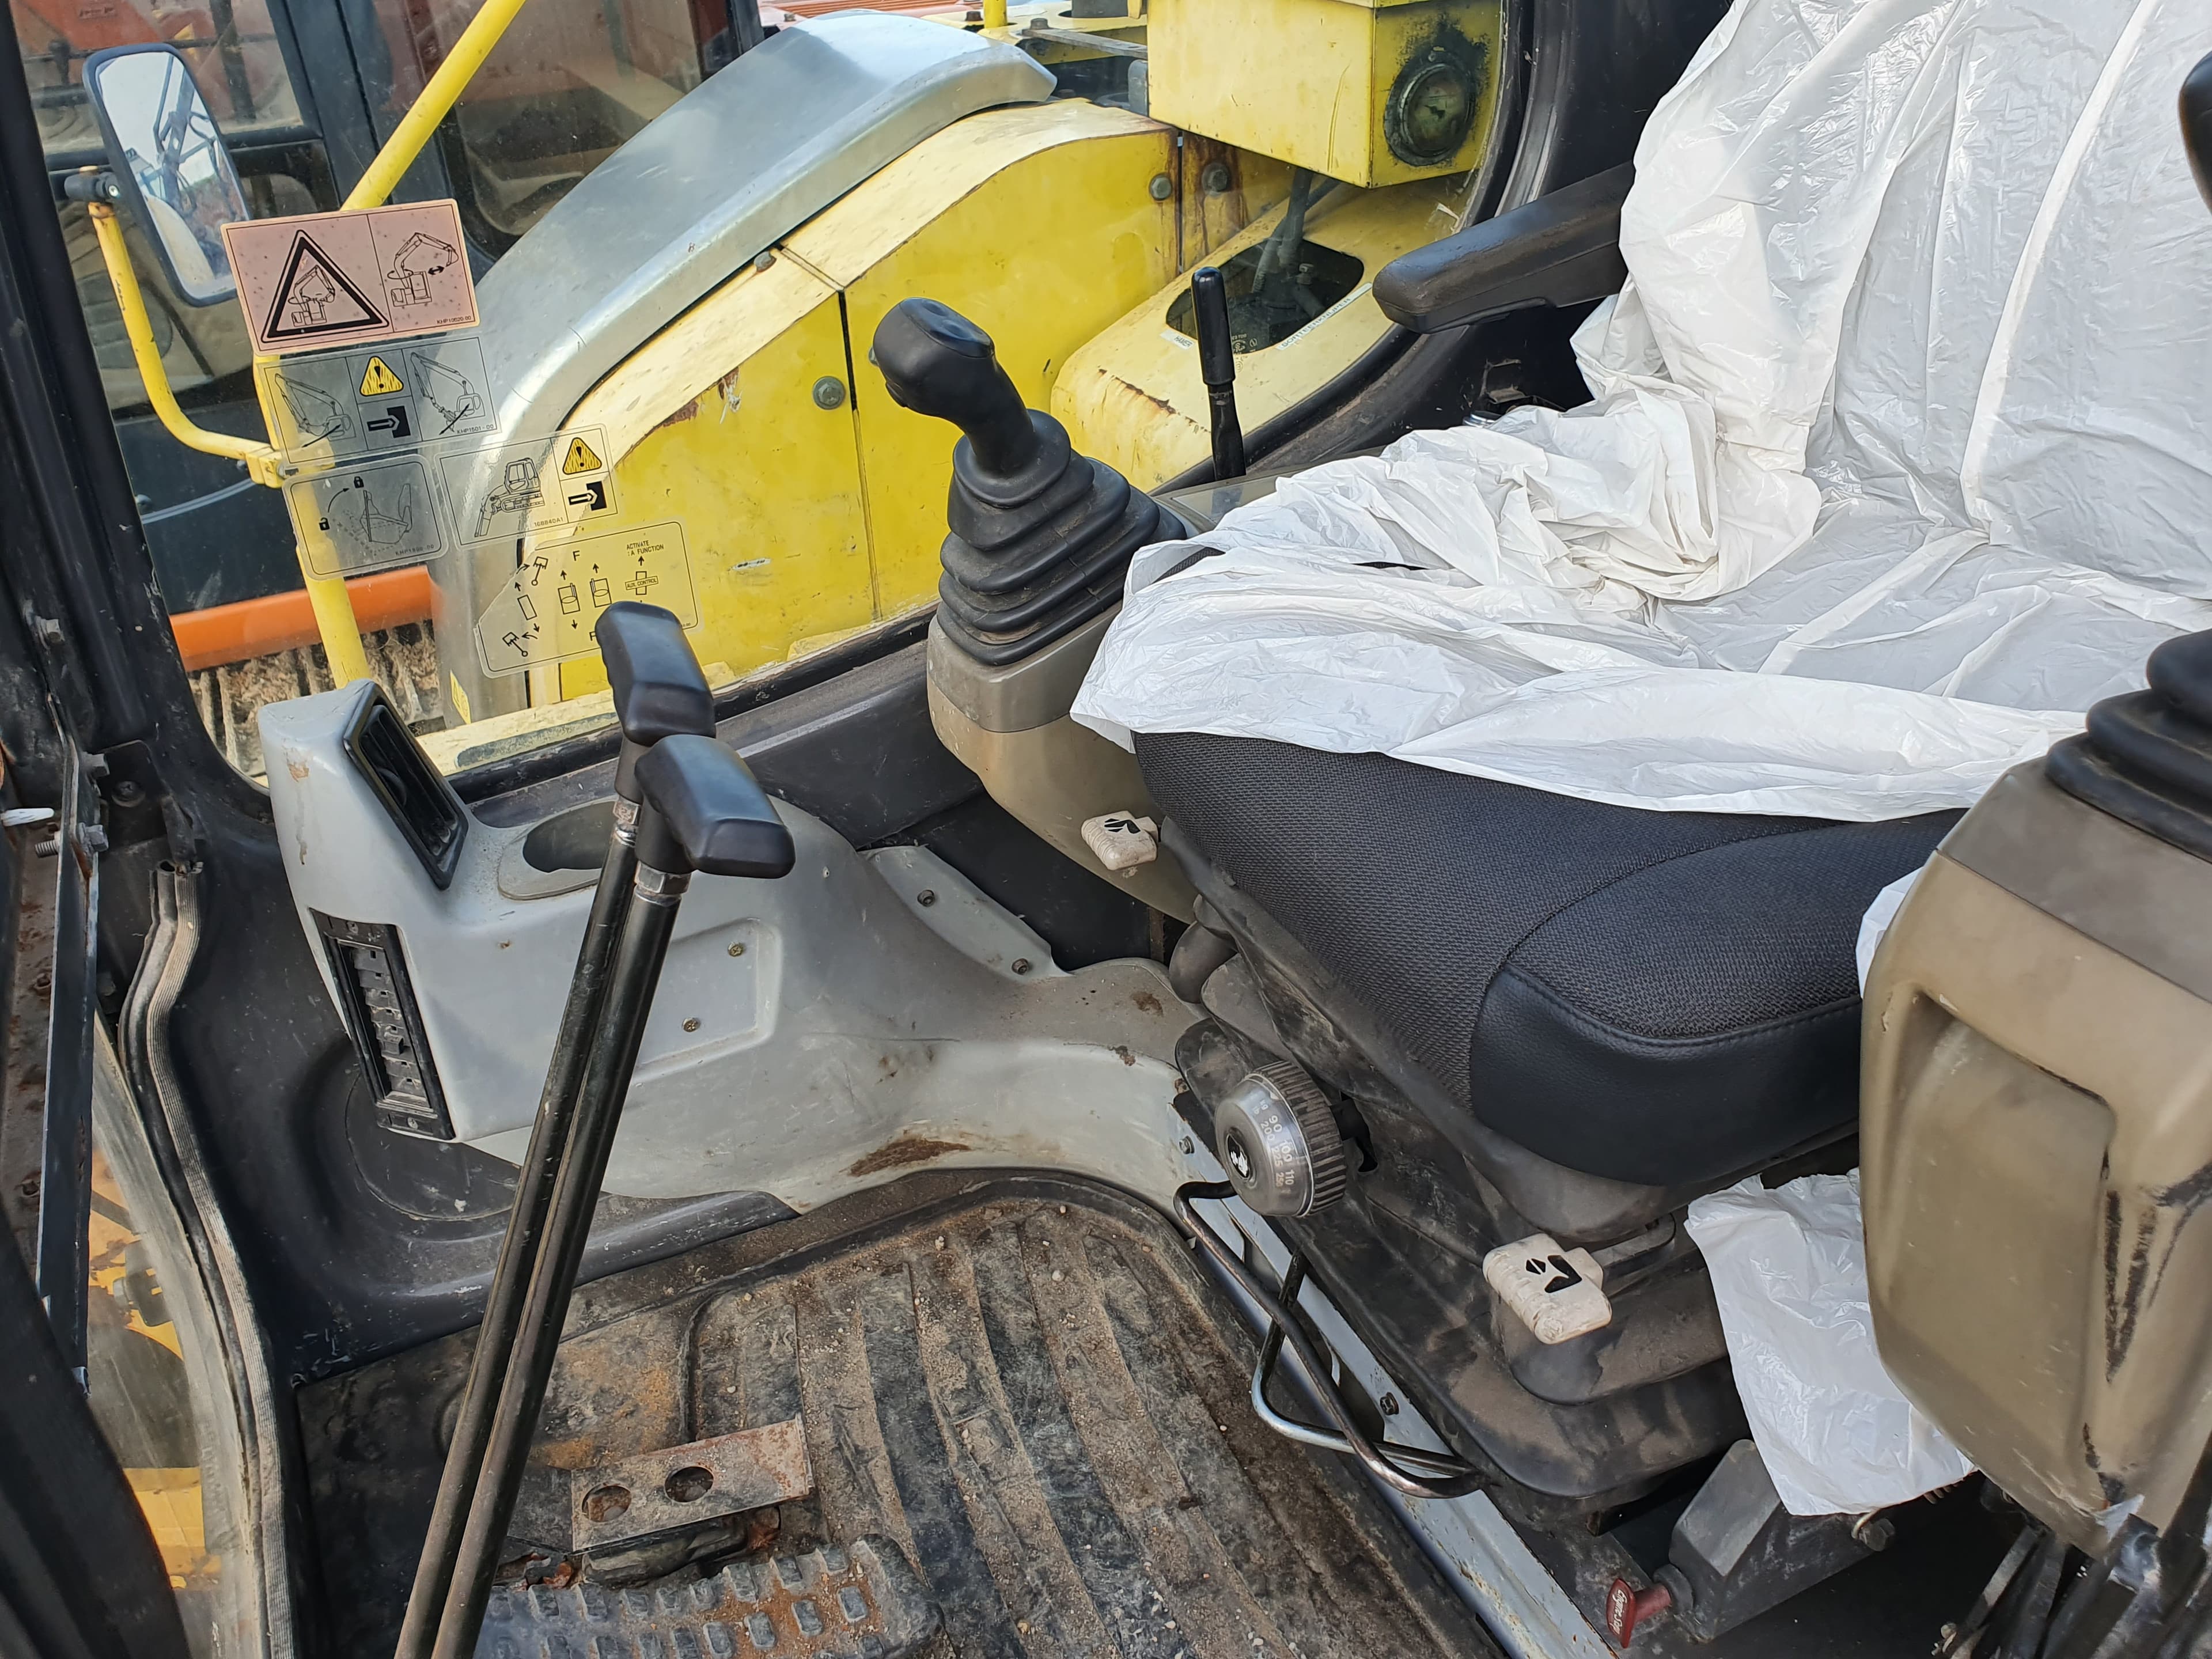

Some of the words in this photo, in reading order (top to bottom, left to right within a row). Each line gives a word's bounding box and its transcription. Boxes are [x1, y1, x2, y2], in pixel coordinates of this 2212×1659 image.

[627, 540, 649, 550] ACTIVATE
[637, 544, 664, 554] FUNCTION
[573, 550, 581, 562] F
[637, 578, 657, 586] CONTROL
[1269, 1115, 1282, 1132] 90
[1260, 1122, 1275, 1141] 200
[1271, 1146, 1283, 1167] 225
[1280, 1140, 1291, 1162] 100
[1285, 1169, 1295, 1185] 110
